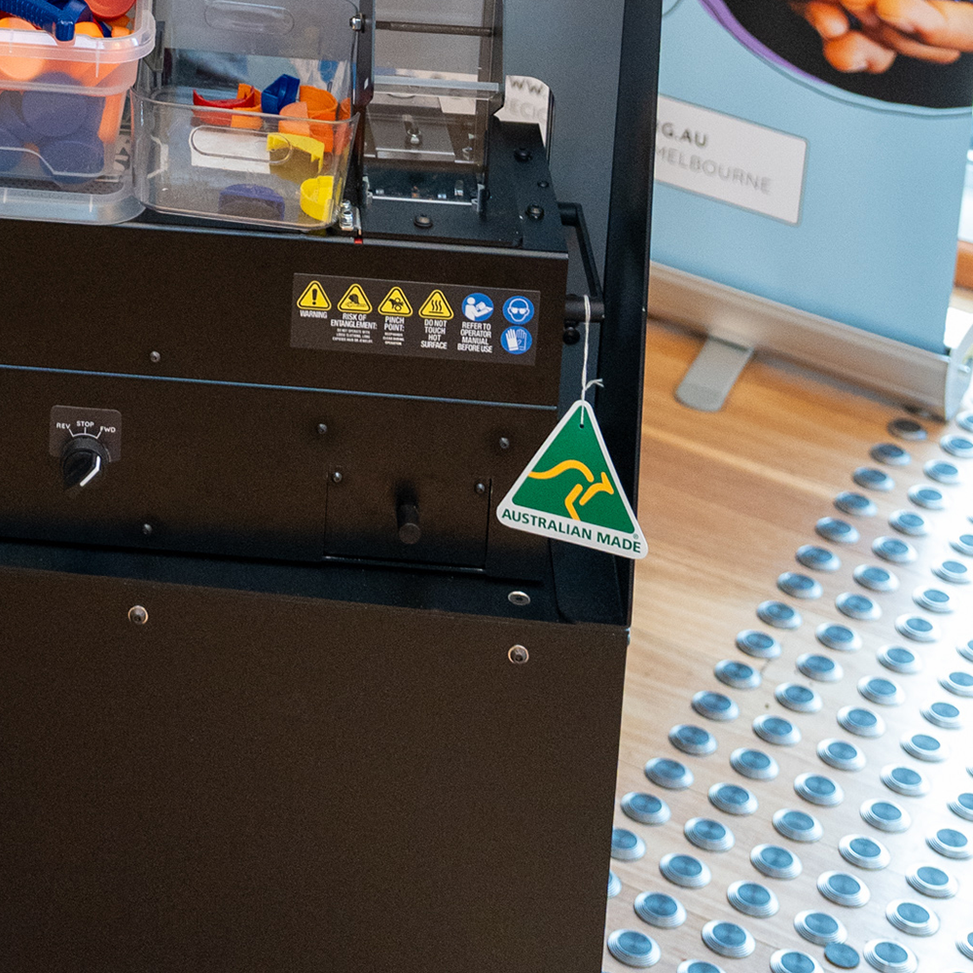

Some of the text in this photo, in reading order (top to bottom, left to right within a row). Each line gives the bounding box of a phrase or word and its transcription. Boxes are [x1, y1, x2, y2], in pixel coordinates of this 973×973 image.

[299, 309, 328, 319] WARNING
[342, 313, 358, 321] RISK
[330, 319, 378, 330] ENTANGLEMENT:
[384, 316, 405, 324] PINCH
[433, 319, 447, 327] NOT
[384, 323, 405, 332] POINT:
[424, 326, 446, 334] TOUCH
[461, 321, 492, 331] REFER TO
[460, 329, 492, 338] OPERATOR
[461, 336, 488, 345] MANUAL
[420, 341, 448, 350] SURFACE
[457, 343, 493, 353] BEFORE USE
[56, 420, 117, 434] REV STOP FWD
[501, 508, 642, 554] AUSTRALIAN MADE
